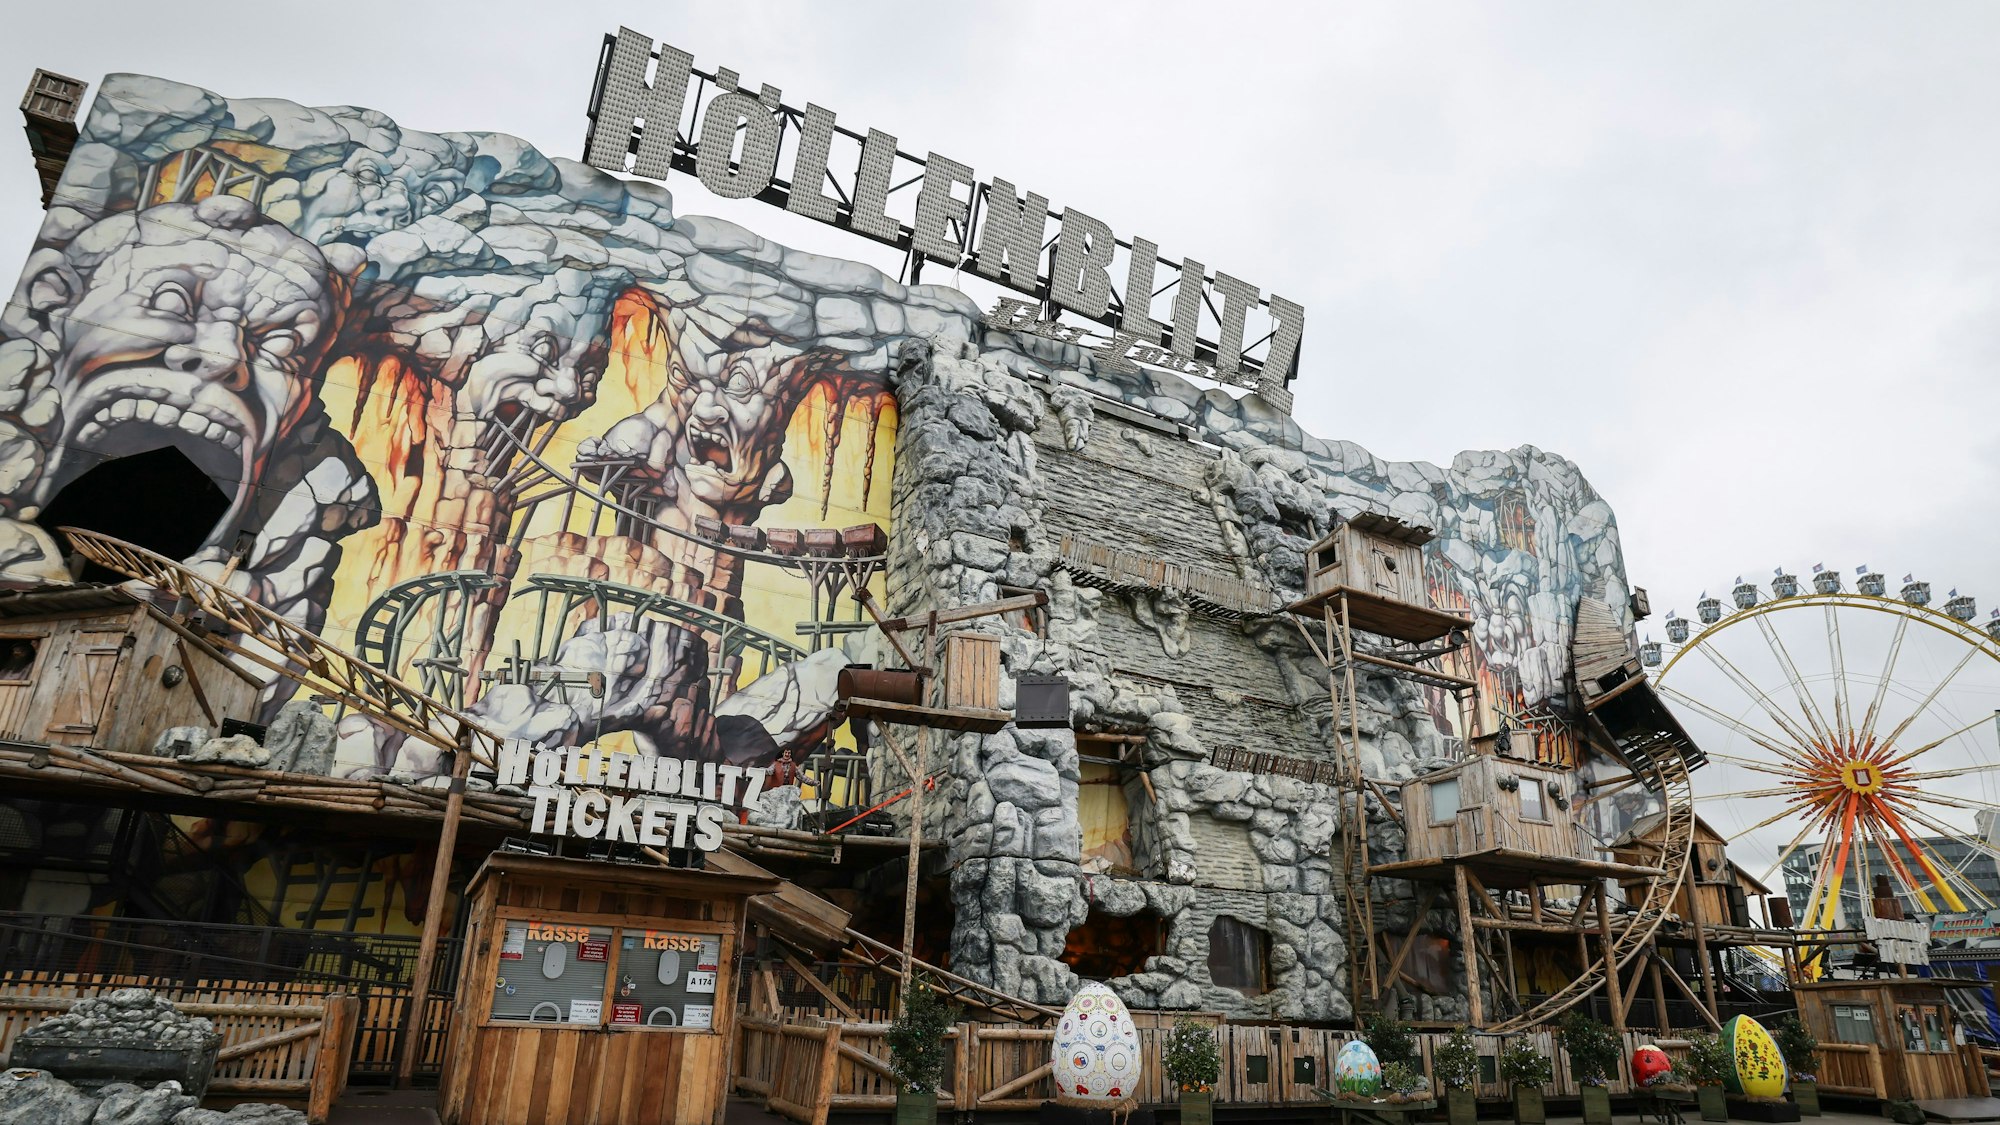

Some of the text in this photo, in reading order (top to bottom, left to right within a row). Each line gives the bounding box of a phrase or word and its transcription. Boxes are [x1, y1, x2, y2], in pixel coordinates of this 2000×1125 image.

[588, 26, 1305, 414] HÖLLENBLITZ
[497, 738, 766, 812] HÖLLENBLITZ
[527, 785, 724, 852] TICKETS
[527, 920, 591, 943] Kasse
[643, 929, 702, 953] Kasse
[690, 977, 712, 987] A 174
